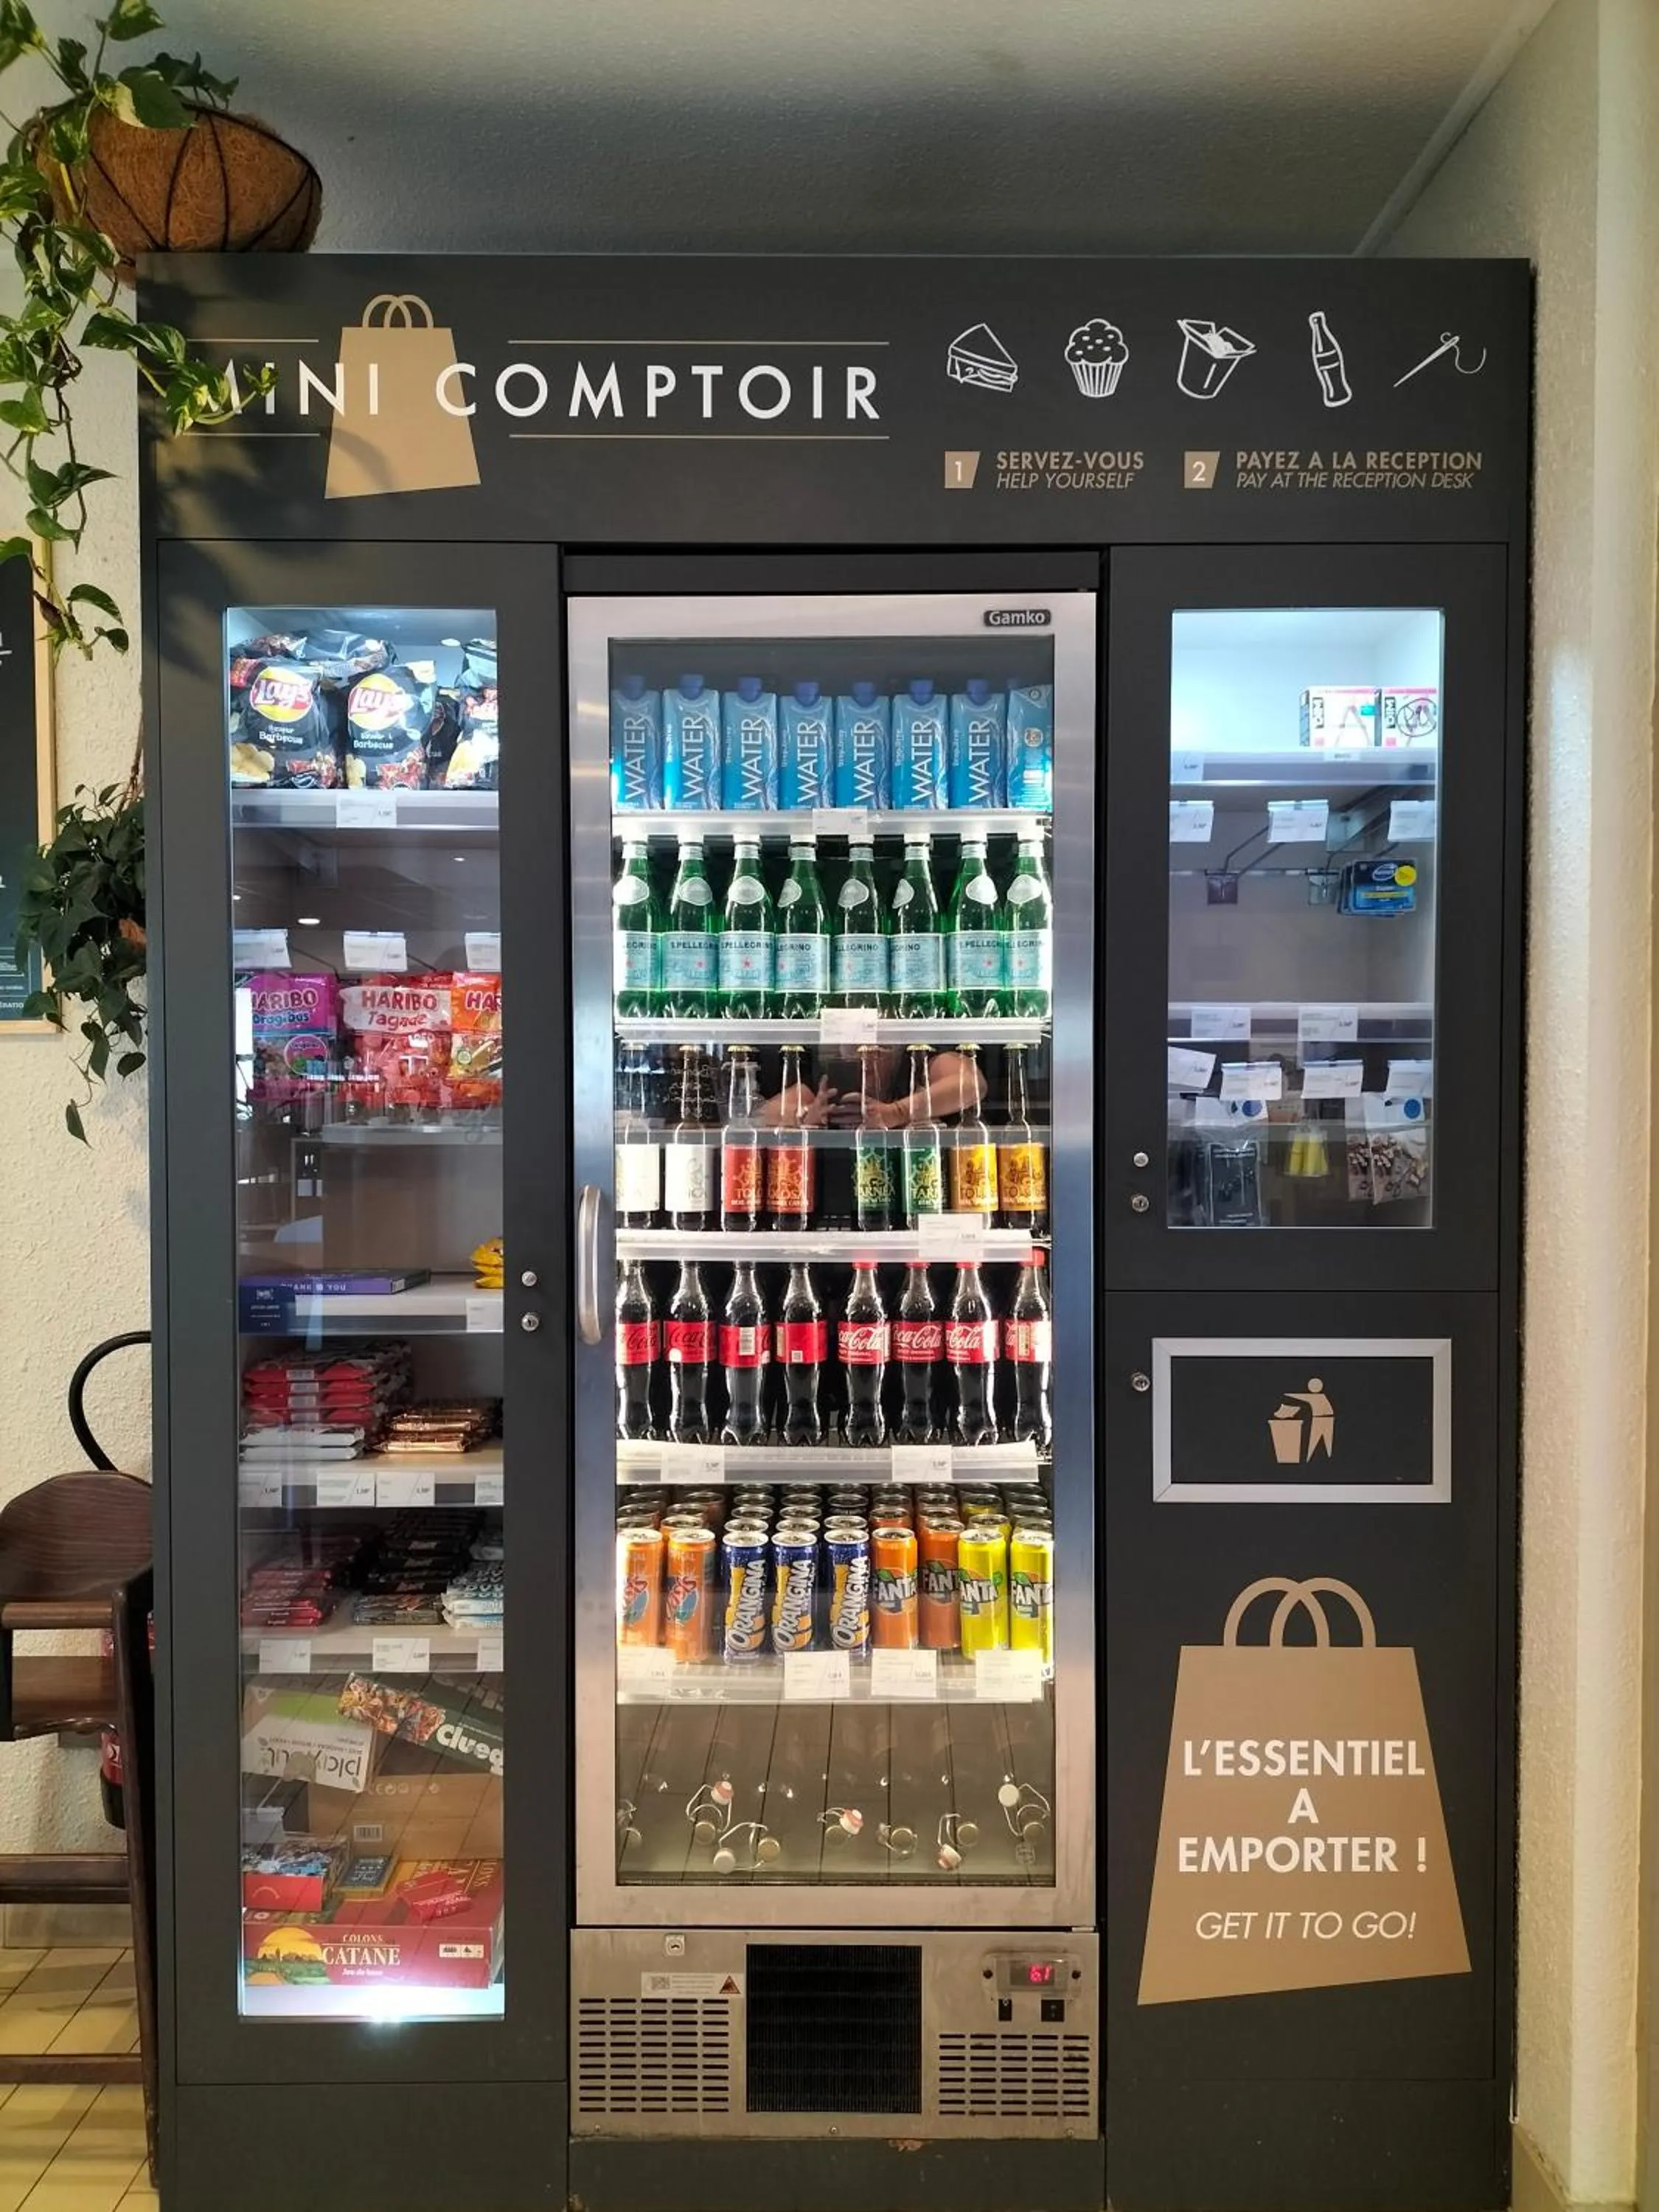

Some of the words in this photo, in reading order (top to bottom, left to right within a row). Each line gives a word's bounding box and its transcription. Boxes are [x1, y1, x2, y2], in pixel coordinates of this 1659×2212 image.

[435, 361, 880, 420] COMPTOIR
[955, 461, 961, 482] 1
[996, 451, 1144, 470] SERVEZ-VOUS
[1192, 461, 1206, 482] 2
[1237, 451, 1300, 470] PAYEZ
[1308, 451, 1324, 470] A
[1332, 451, 1357, 470] LA
[1366, 451, 1483, 470] RECEPTION
[996, 473, 1039, 490] HELP
[1046, 472, 1135, 490] YOURSELF
[1237, 472, 1267, 489] PAY
[1270, 472, 1293, 489] AT
[1297, 472, 1328, 489] THE
[1332, 472, 1427, 489] RECEPTION
[1431, 472, 1475, 489] DESK
[989, 610, 1046, 625] Gamko
[624, 716, 647, 799] WATER
[682, 715, 706, 799] WATER
[741, 718, 763, 799] WATER
[797, 721, 820, 802] WATER
[854, 720, 875, 802] WATER
[911, 720, 933, 802] WATER
[969, 720, 991, 802] WATER
[361, 990, 438, 1010] HARIBO
[465, 990, 501, 1012] HAR
[873, 1576, 917, 1601] FANTA
[922, 1568, 958, 1593] FANT
[960, 1580, 998, 1603] ANTA
[728, 1559, 766, 1649] ORANGINA
[773, 1559, 812, 1647] ORANGINA
[832, 1556, 869, 1646] ORANGINA
[1183, 1739, 1425, 1777] L'ESSENTIEL
[1287, 1788, 1319, 1823] A
[1180, 1836, 1399, 1873] EMPORTER
[1416, 1837, 1427, 1873] !
[1195, 1911, 1258, 1940] GET
[1265, 1912, 1291, 1939] IT
[1300, 1911, 1343, 1940] TO
[1352, 1911, 1417, 1940] GO!
[322, 1945, 401, 1966] CATANE
